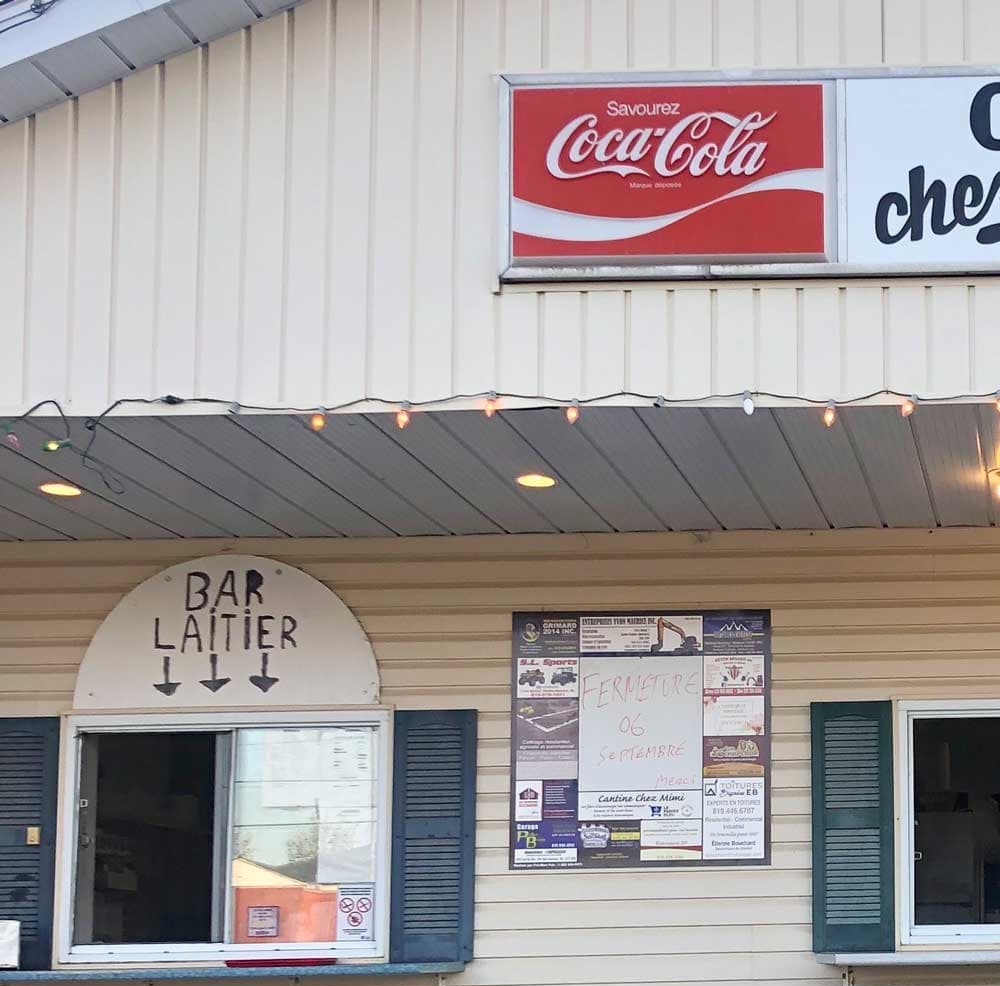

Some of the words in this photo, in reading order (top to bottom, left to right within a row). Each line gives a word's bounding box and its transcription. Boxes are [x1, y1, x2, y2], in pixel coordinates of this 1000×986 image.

[607, 100, 680, 117] Savourez
[546, 111, 777, 180] Coca-Cola
[185, 569, 264, 612] BAR
[543, 658, 577, 667] Sports
[582, 671, 699, 709] FERMETURE
[619, 713, 645, 736] 06
[598, 793, 633, 803] Cantine
[635, 792, 657, 802] Chez
[659, 792, 687, 801] Mimi
